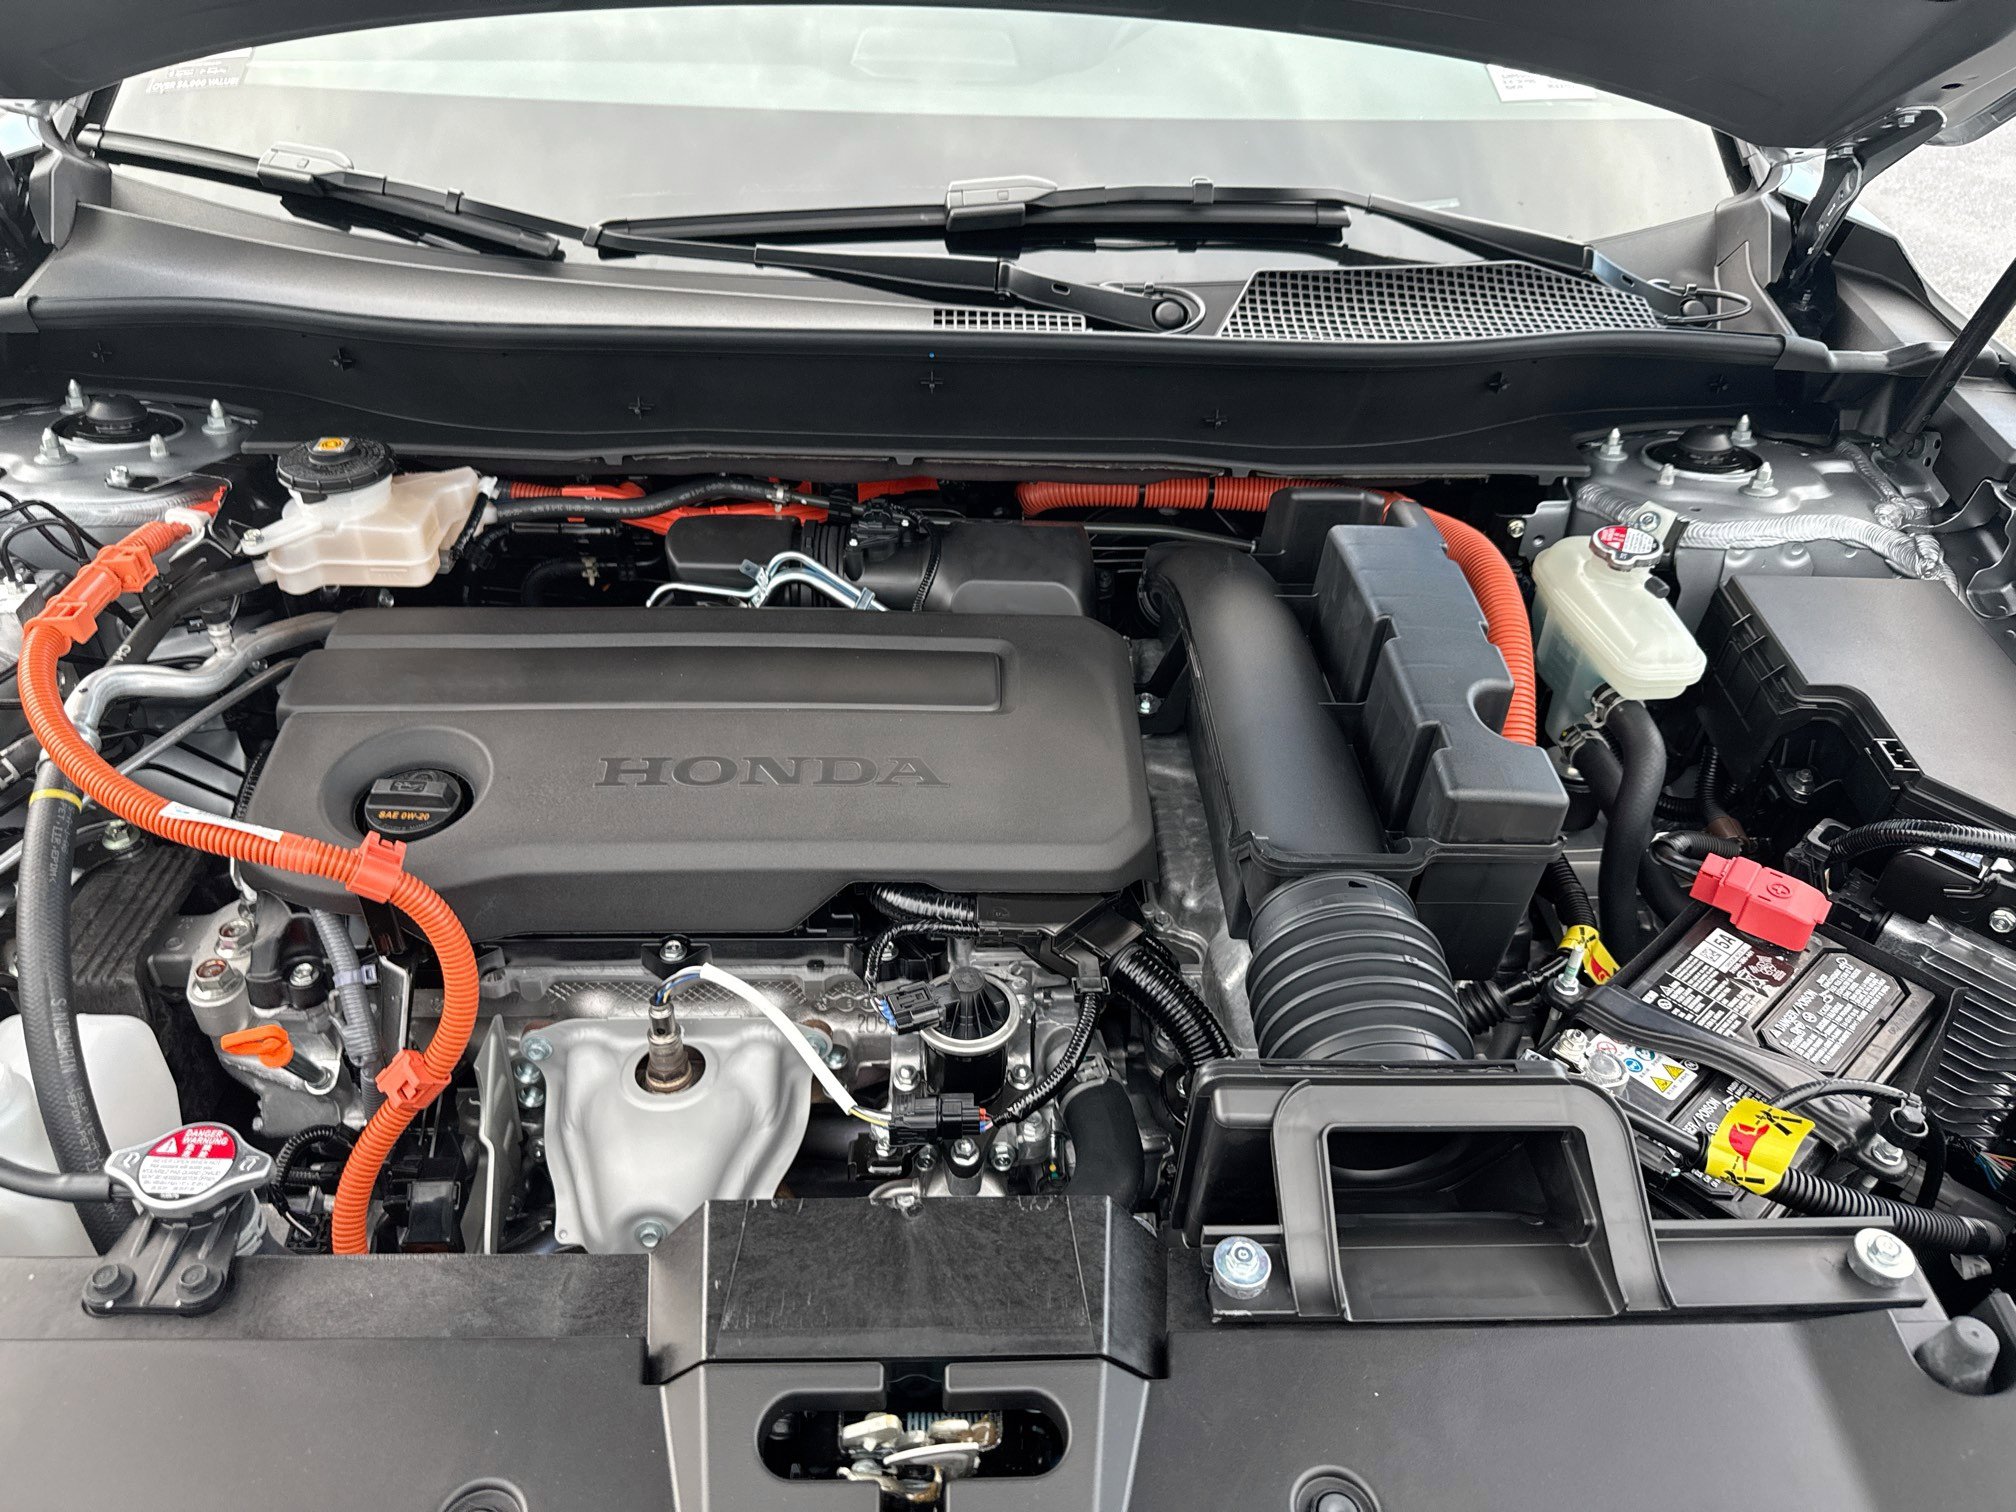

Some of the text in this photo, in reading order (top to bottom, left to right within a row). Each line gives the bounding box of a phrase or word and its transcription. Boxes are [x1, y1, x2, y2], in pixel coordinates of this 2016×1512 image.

[593, 757, 950, 789] HONDA
[378, 810, 430, 822] SAE 0W-20
[1714, 934, 1737, 950] 5A
[184, 1128, 224, 1138] DANGER
